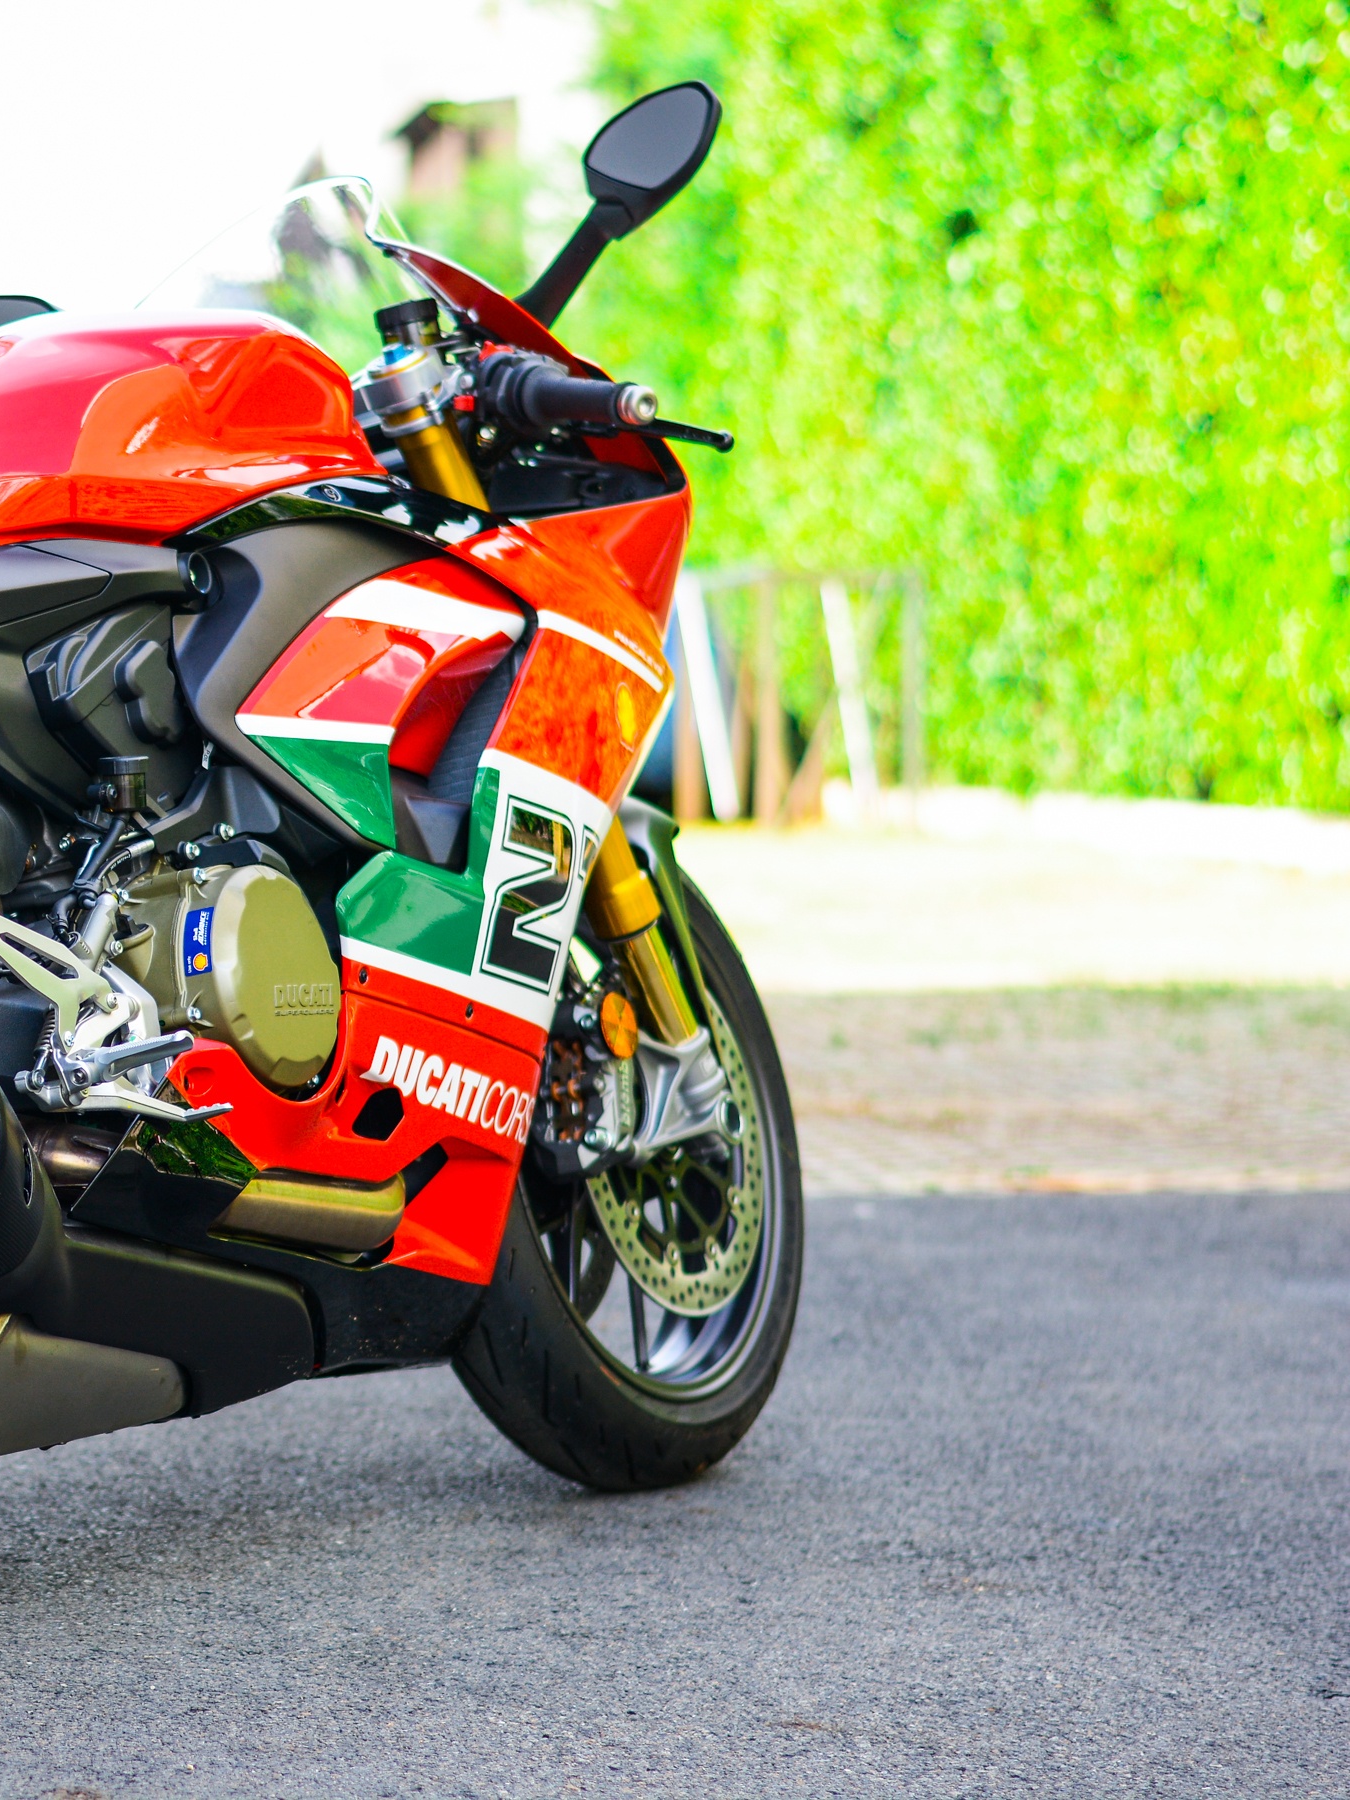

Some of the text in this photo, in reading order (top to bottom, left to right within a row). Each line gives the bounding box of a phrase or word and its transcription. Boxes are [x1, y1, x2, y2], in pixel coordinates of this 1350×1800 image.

[197, 911, 206, 945] ADVANCE
[273, 983, 335, 1009] DUCATI
[618, 1060, 631, 1127] bremb
